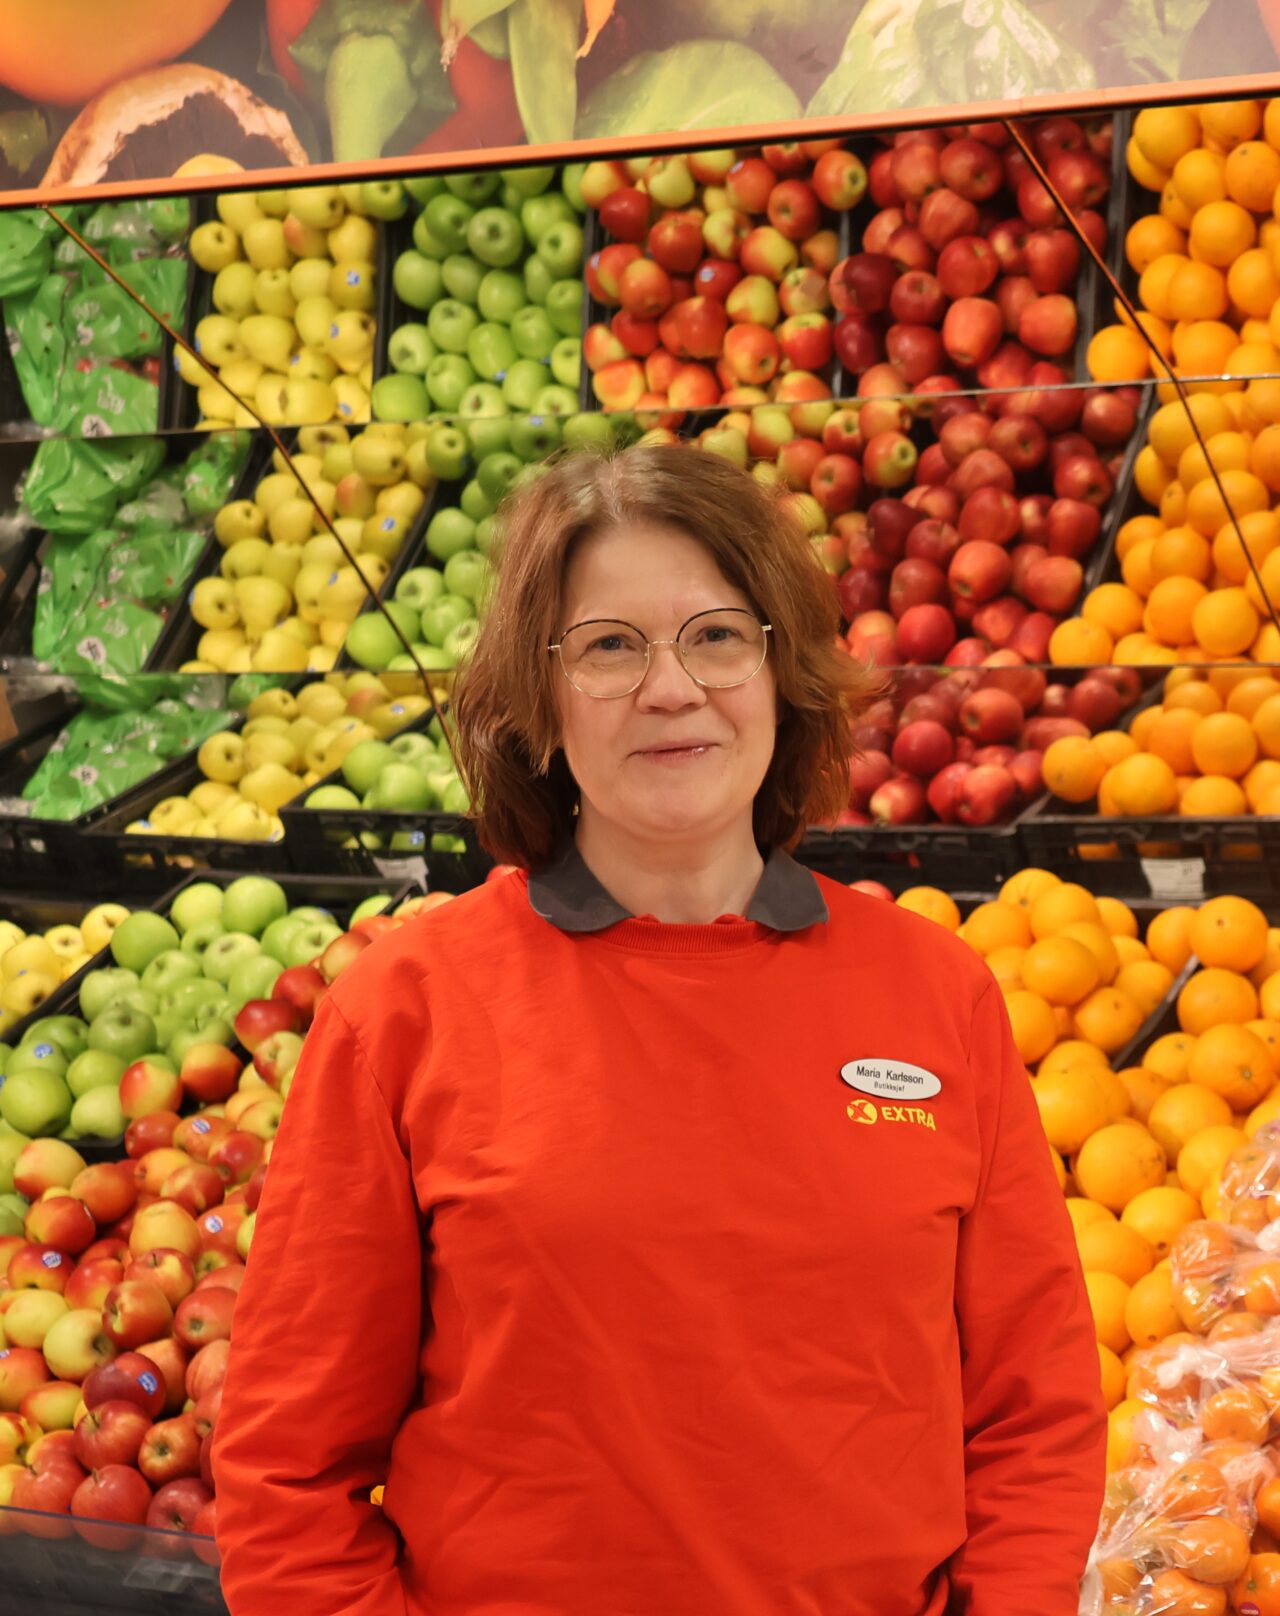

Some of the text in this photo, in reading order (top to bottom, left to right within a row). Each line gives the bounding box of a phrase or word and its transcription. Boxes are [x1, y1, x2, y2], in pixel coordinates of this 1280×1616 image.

[856, 1065, 924, 1085] Maria Karlsson
[881, 1106, 936, 1131] EXTRA
